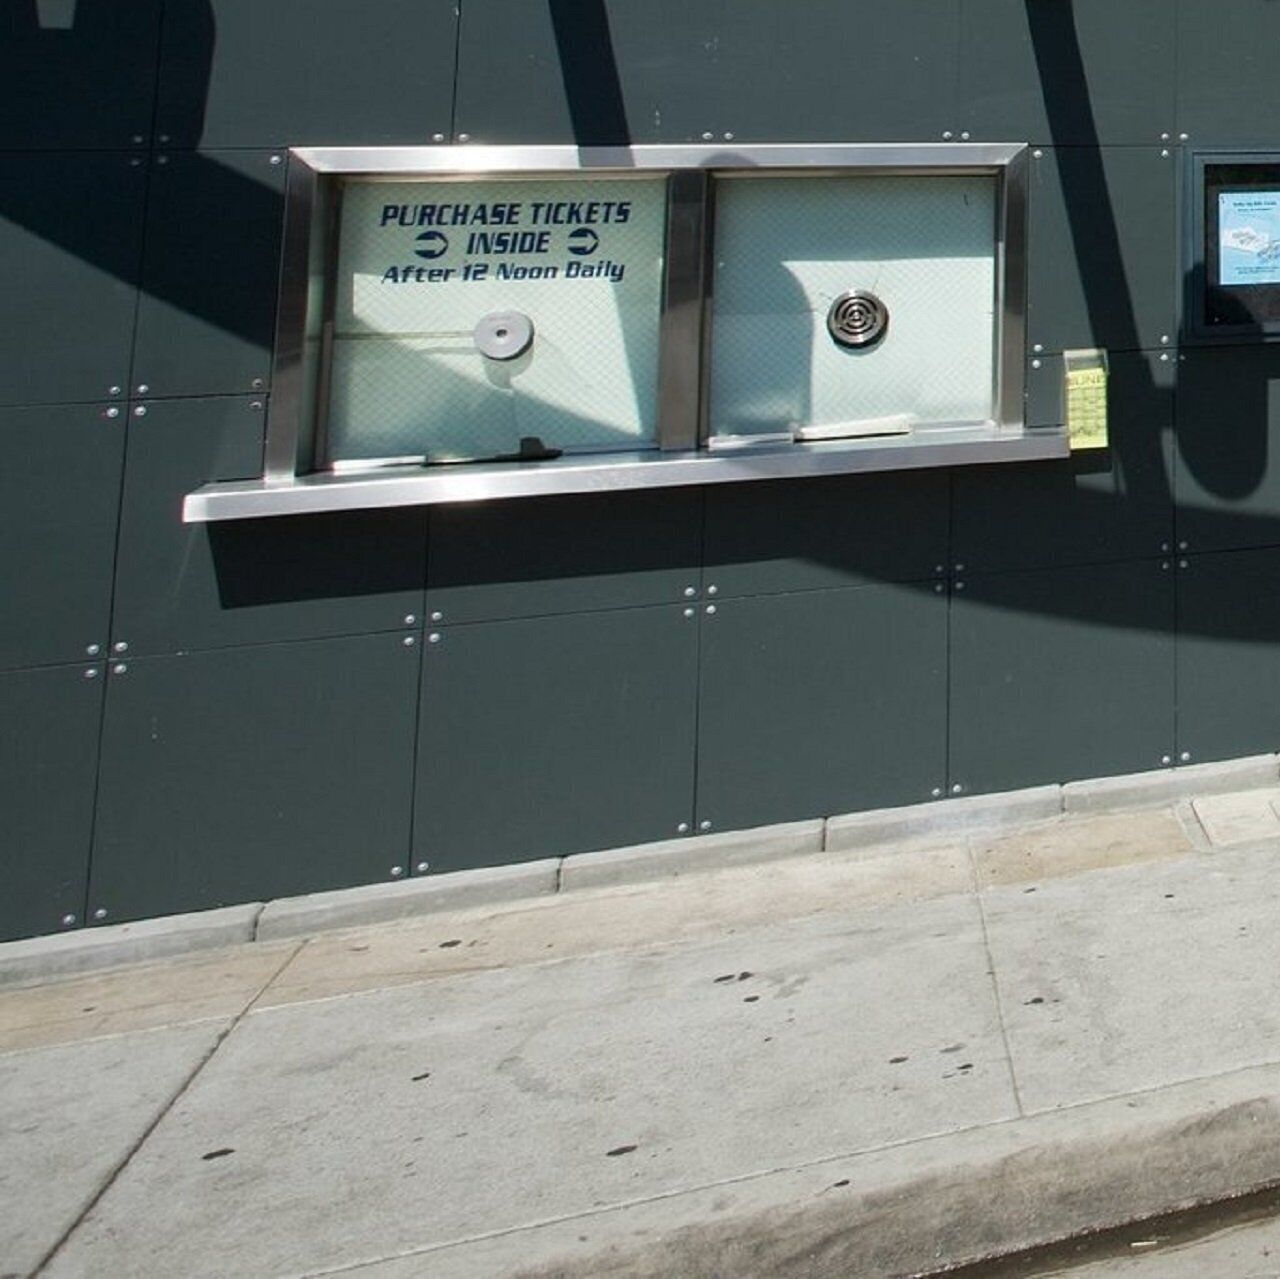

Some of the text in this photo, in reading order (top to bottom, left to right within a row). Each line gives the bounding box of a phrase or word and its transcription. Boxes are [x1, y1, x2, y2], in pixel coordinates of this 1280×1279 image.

[379, 201, 633, 227] PURCHASE TICKETS
[466, 231, 552, 255] INSIDE
[380, 260, 627, 284] After 12 Noon Daily
